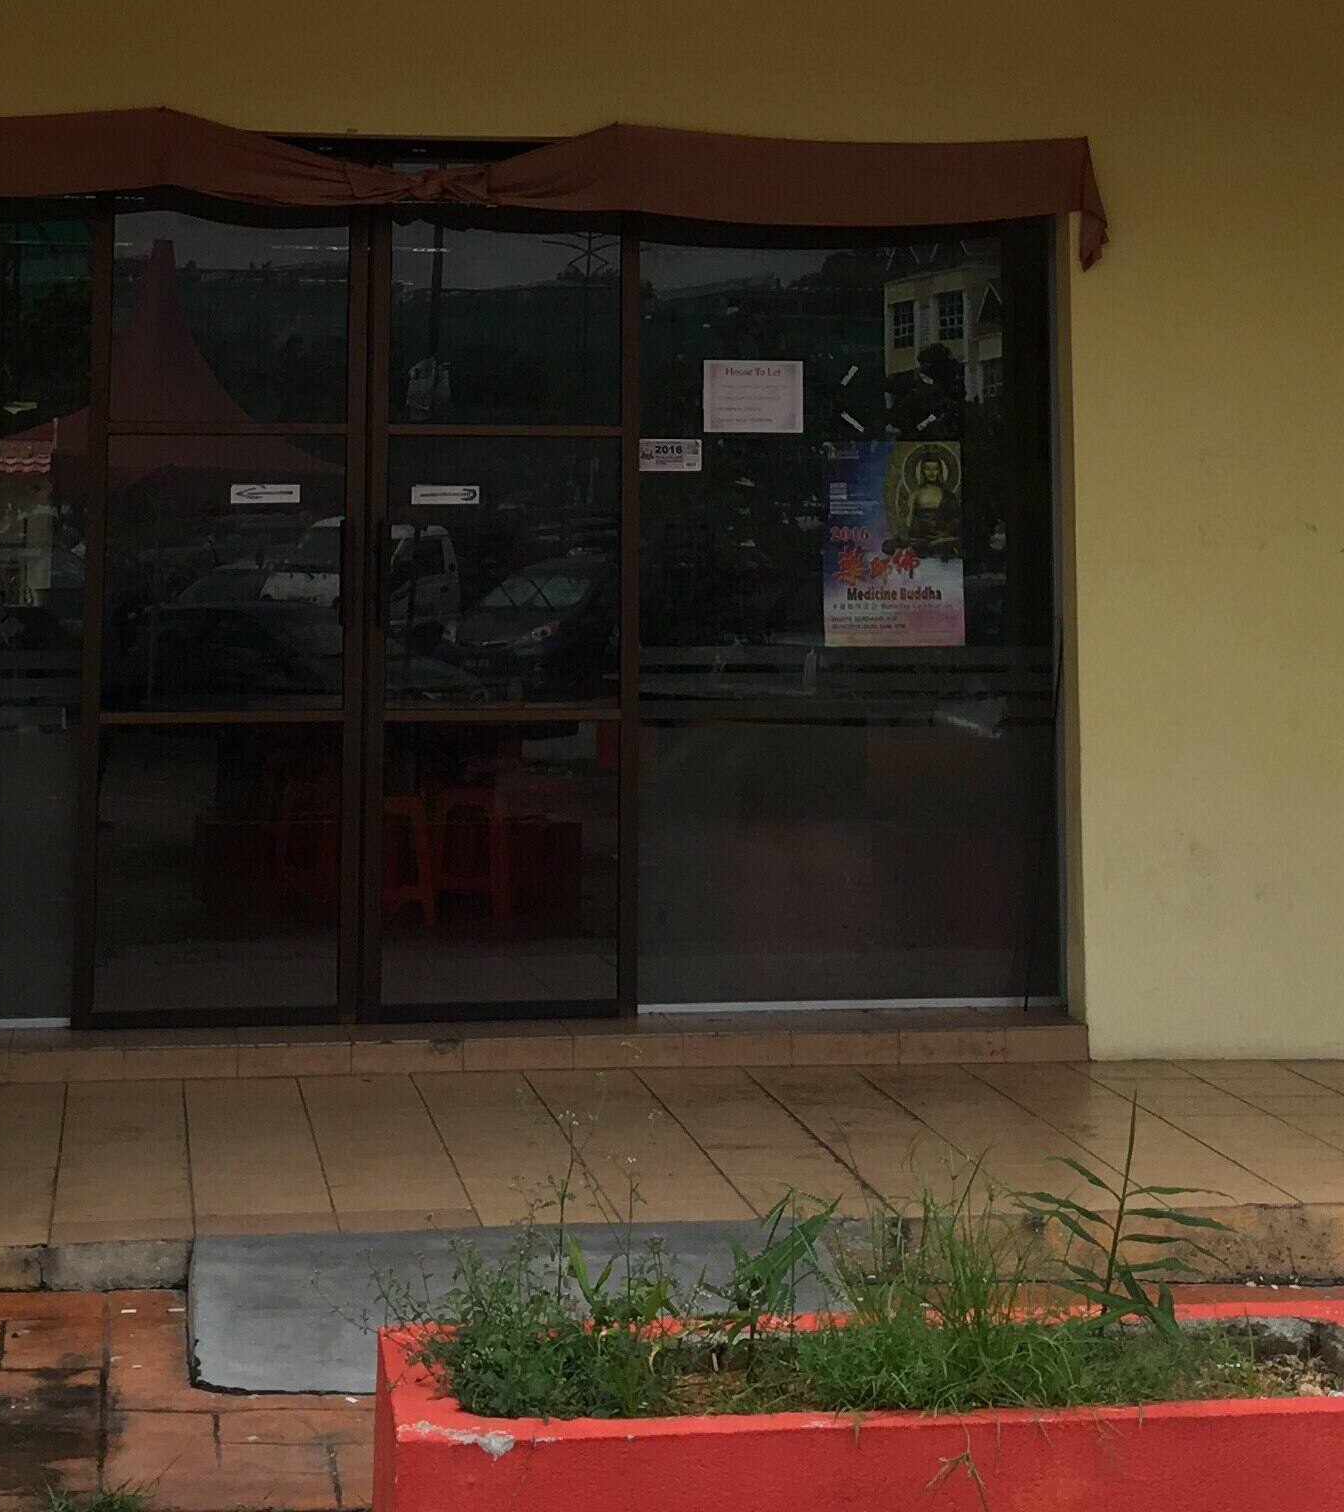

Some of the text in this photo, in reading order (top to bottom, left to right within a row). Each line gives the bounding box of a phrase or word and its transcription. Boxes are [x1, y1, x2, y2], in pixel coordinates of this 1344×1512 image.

[754, 367, 766, 377] To
[655, 445, 683, 455] 2016
[847, 586, 942, 601] Medicine Buddha
